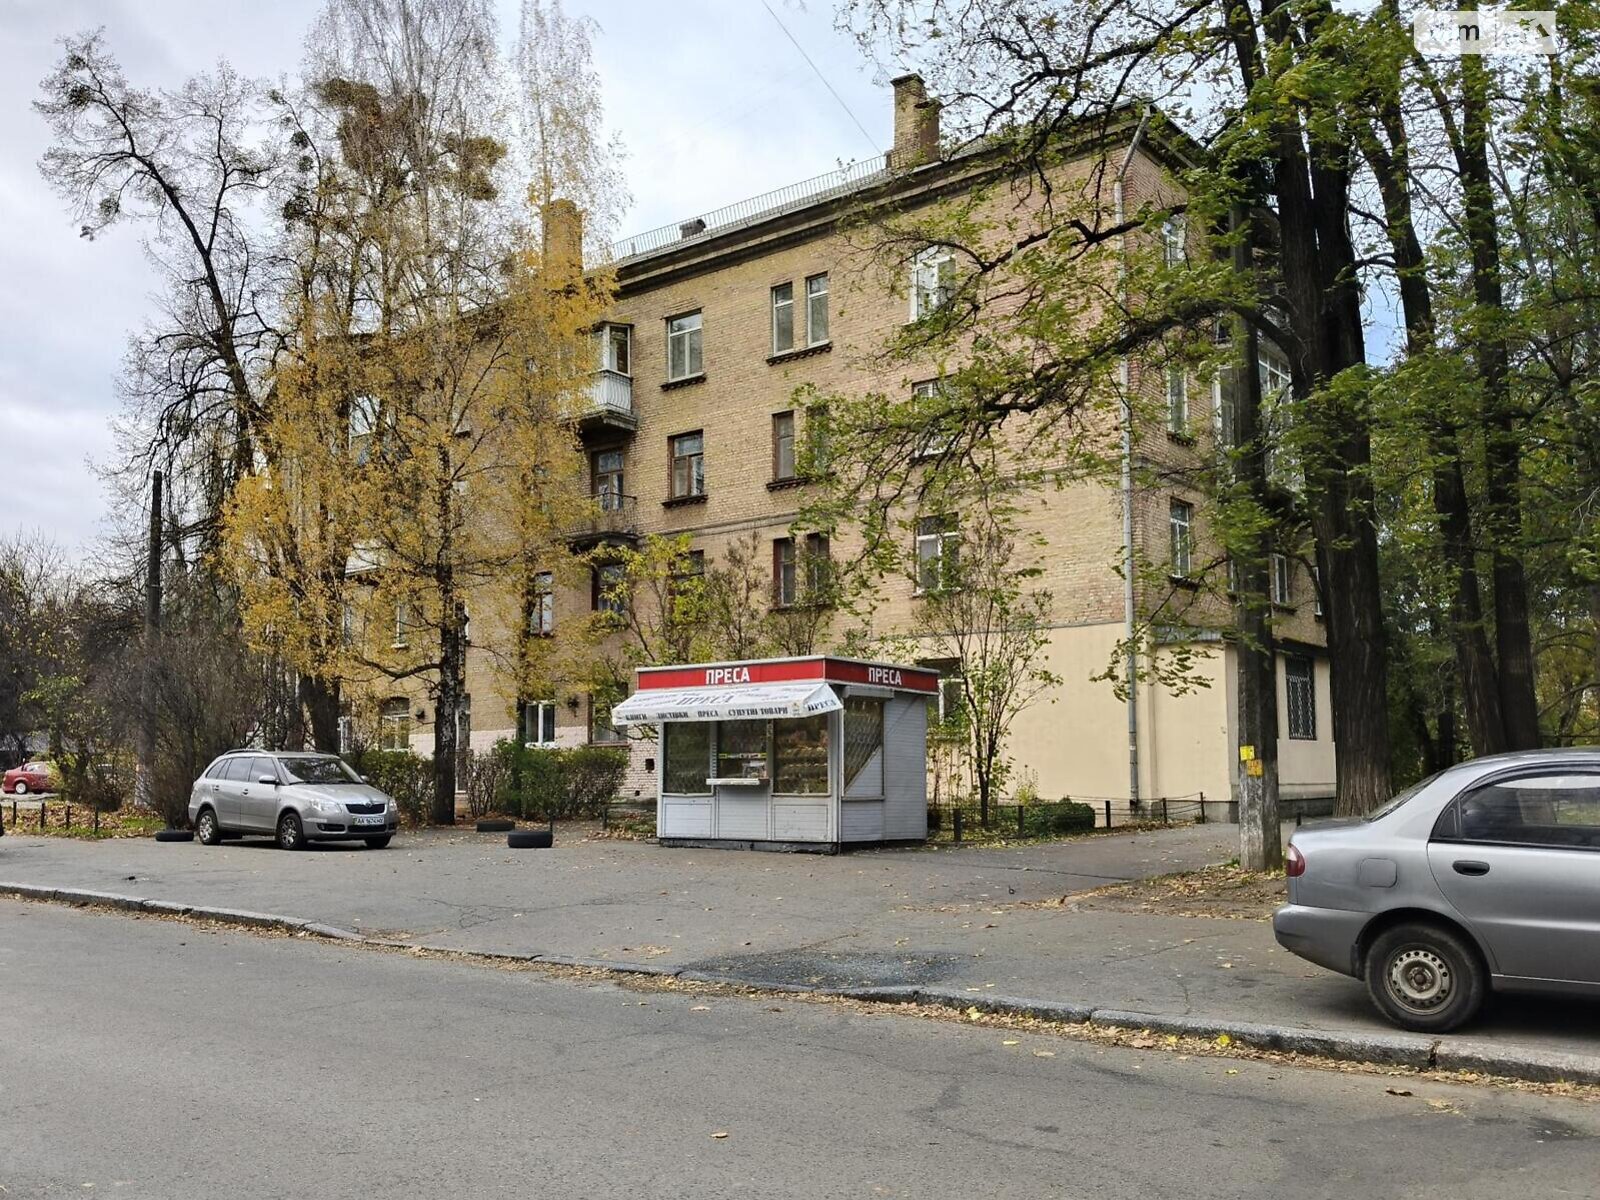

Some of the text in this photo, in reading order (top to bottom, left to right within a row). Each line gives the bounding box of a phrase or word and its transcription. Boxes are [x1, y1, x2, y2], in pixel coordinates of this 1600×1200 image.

[705, 667, 750, 685] ПРЕСА
[868, 667, 902, 686] ПРЕСА
[676, 694, 735, 706] ПРЕСА
[807, 699, 837, 712] ПРЕСА
[698, 710, 719, 718] ПРЕСА
[728, 707, 758, 717] СУПУТНІ
[760, 706, 788, 715] ТОВАРИ
